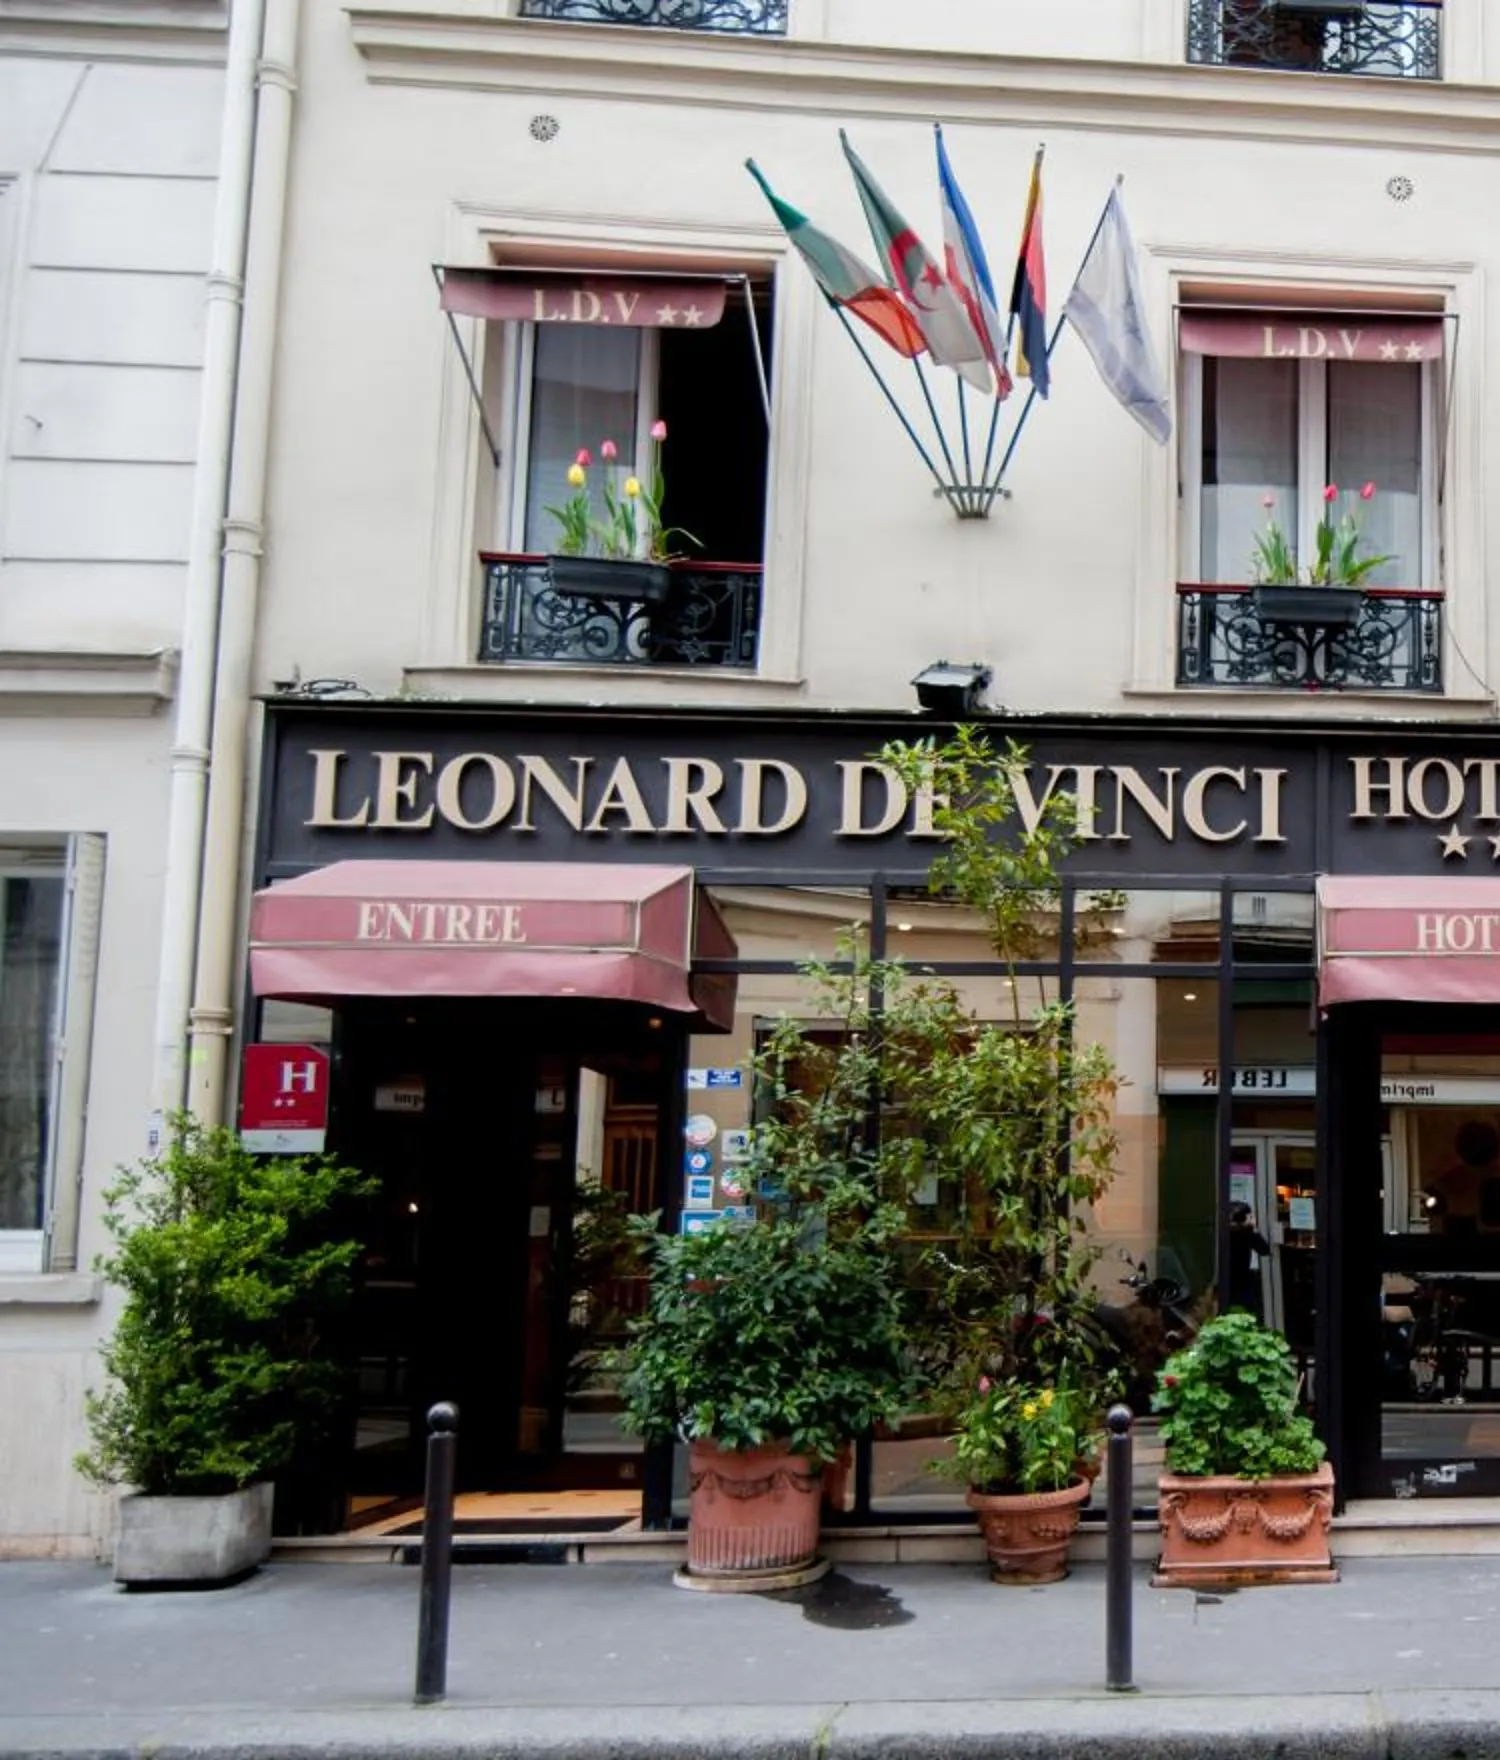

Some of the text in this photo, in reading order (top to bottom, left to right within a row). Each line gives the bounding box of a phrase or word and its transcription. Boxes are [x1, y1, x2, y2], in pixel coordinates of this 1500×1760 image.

[531, 288, 640, 324] L.D.V
[1263, 326, 1362, 359] L.D.V
[304, 749, 808, 834] LEONARD
[994, 762, 1289, 844] VINCI
[356, 901, 527, 945] ENTREE
[277, 1061, 321, 1093] H
